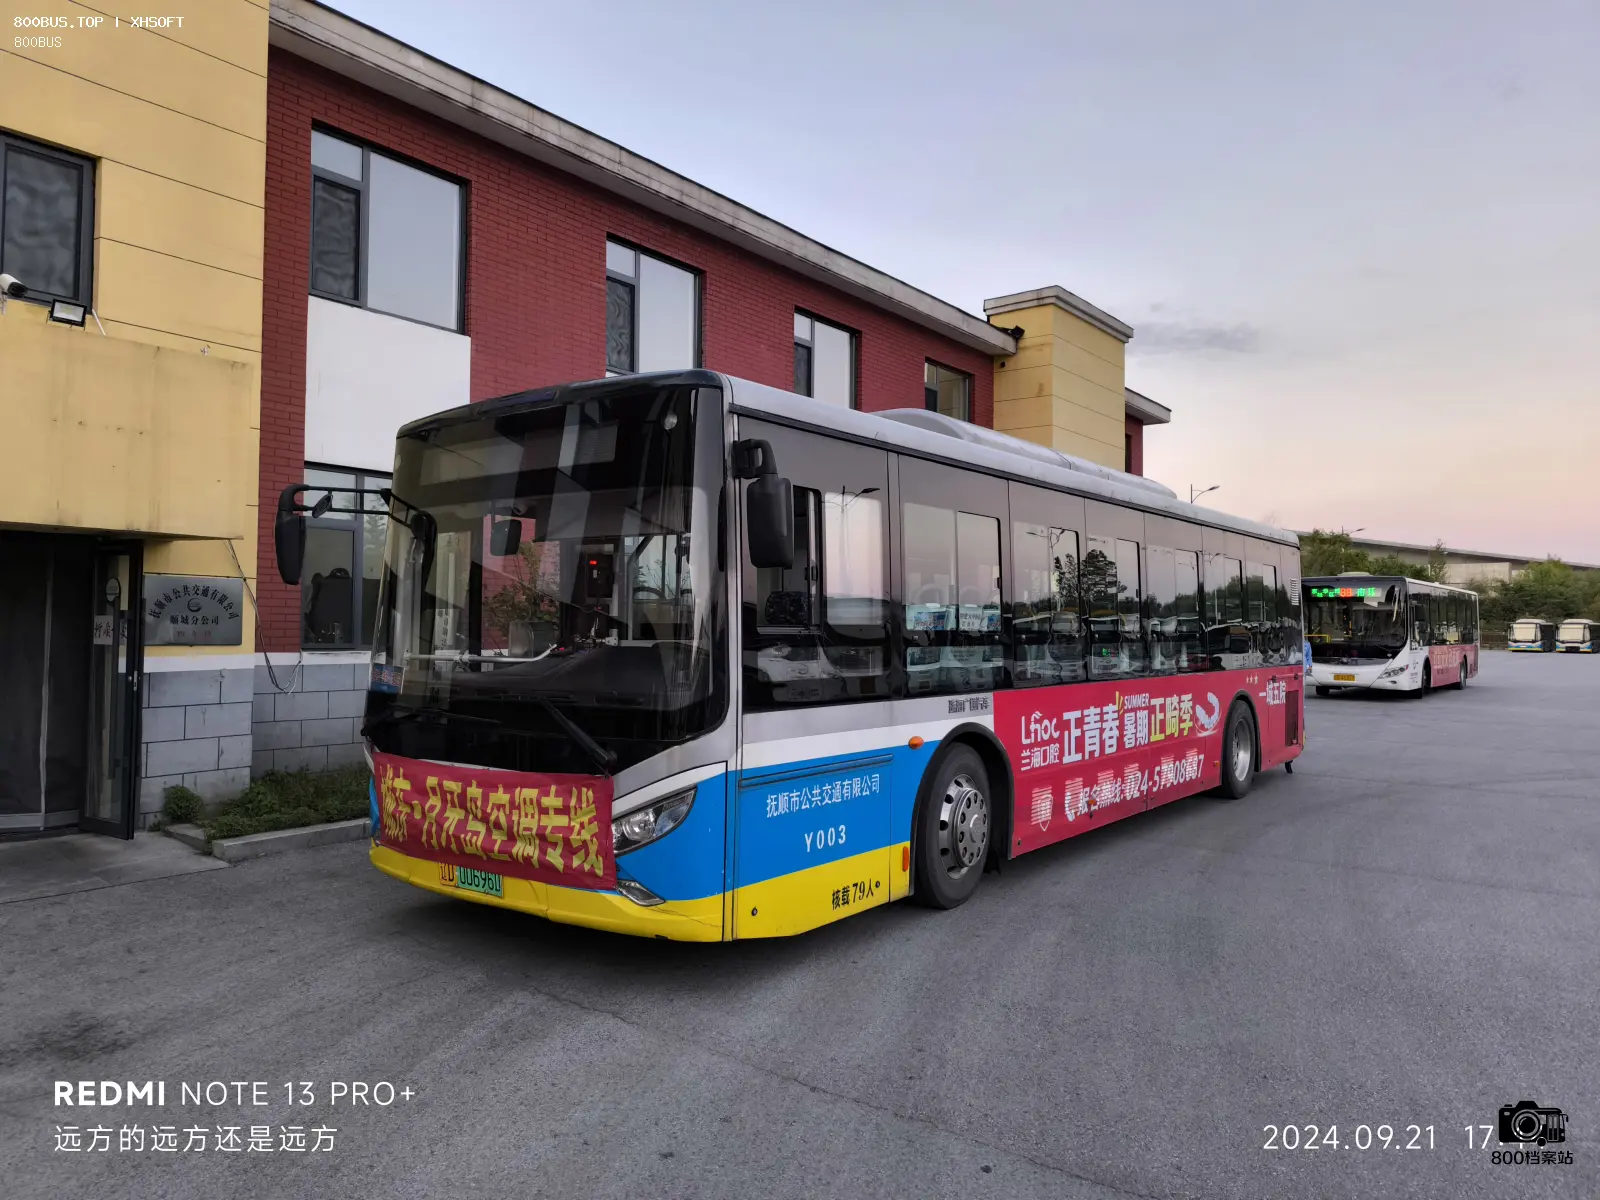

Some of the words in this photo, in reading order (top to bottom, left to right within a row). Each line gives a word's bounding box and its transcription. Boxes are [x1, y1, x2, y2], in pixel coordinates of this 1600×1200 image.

[148, 583, 240, 620] 抚顺市公共交通有限公司
[170, 615, 219, 626] 顺城分公司
[1124, 693, 1149, 709] SUMMER
[1062, 703, 1120, 764] 正青春
[1123, 709, 1149, 749] 暑期
[1149, 693, 1193, 743] 正畸季
[1020, 743, 1060, 772] 兰海口腔
[766, 773, 880, 818] 抚顺市公共交通有限公司
[804, 824, 846, 853] Y003
[832, 878, 874, 910] 核载79人
